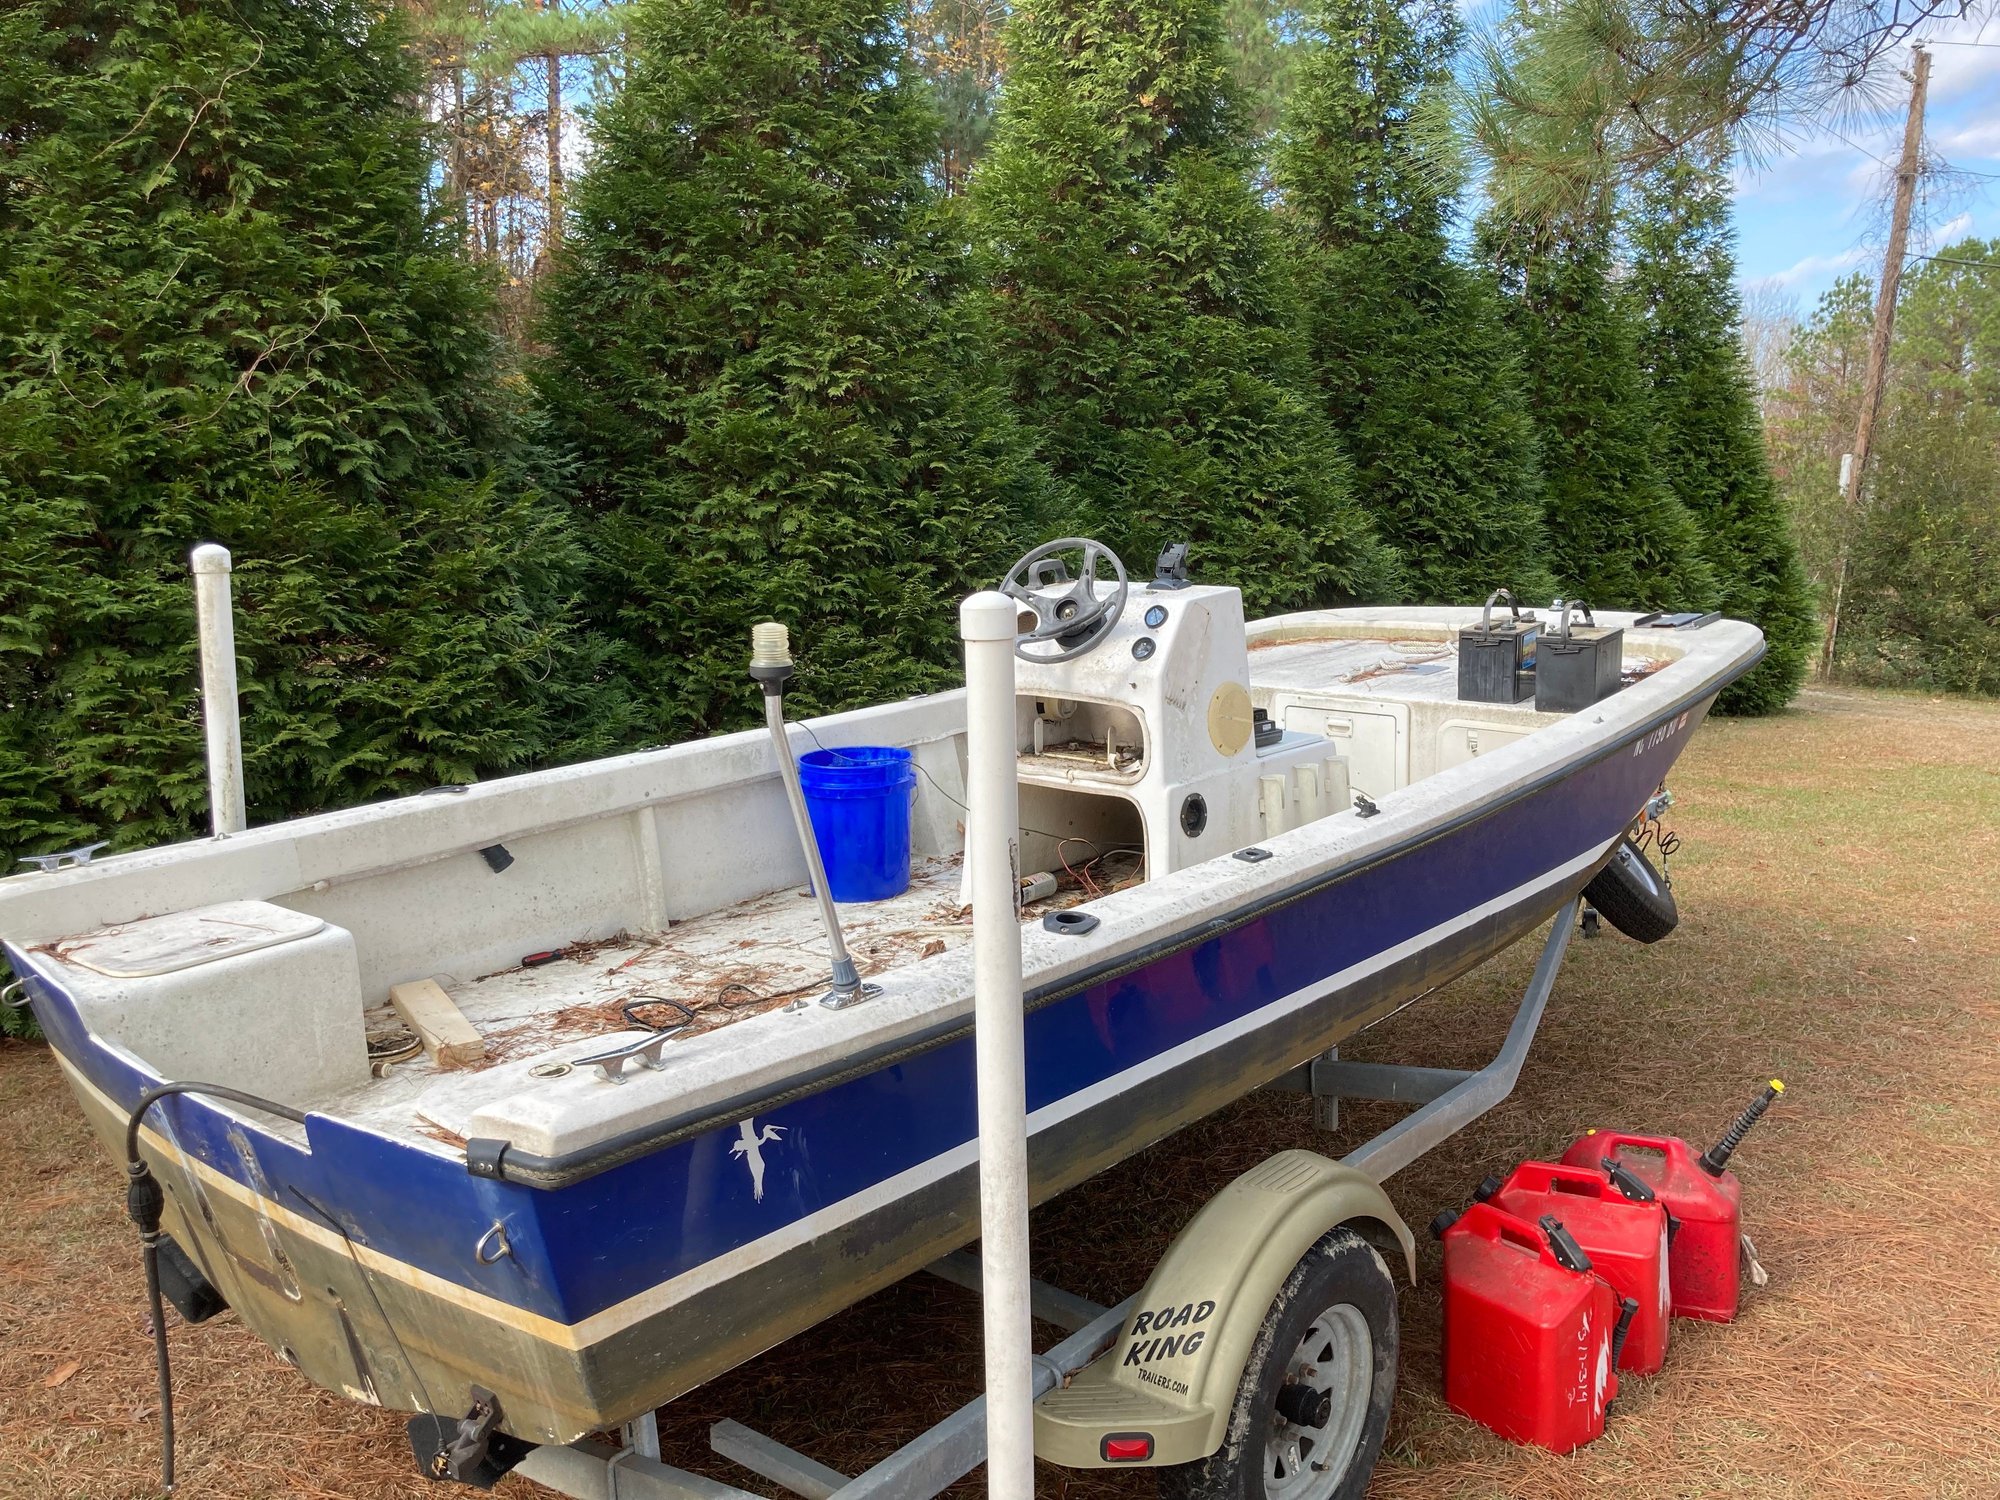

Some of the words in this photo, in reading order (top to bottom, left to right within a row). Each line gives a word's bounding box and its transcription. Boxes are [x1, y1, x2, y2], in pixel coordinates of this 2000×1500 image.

[1131, 1300, 1216, 1335] ROAD
[1123, 1331, 1206, 1366] KING
[1137, 1367, 1189, 1396] TRAILERS.COM
